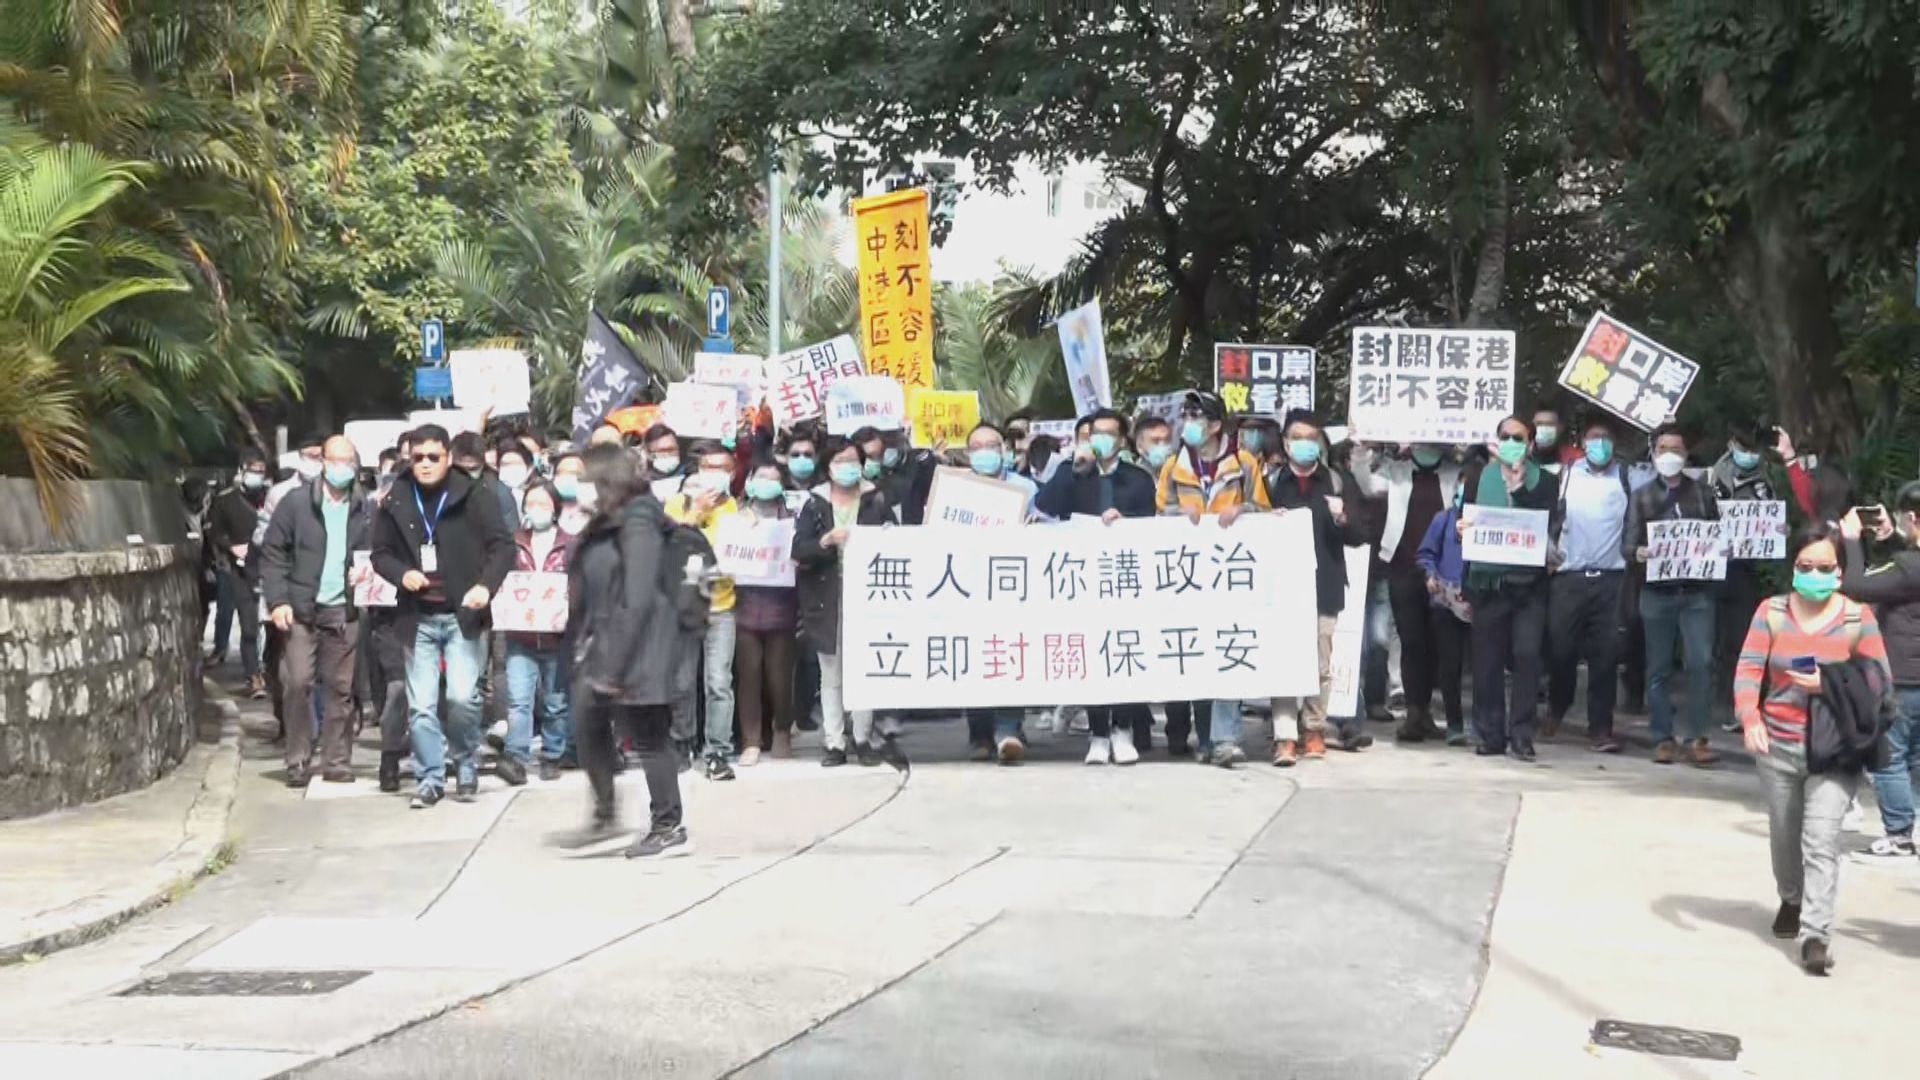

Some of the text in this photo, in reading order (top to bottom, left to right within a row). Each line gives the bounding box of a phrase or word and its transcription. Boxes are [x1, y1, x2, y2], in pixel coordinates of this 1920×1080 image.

[711, 292, 725, 330] P
[895, 217, 926, 388] 刻不容緩
[424, 324, 440, 357] P
[1357, 332, 1510, 371] 封關保港
[780, 342, 838, 378] 立即
[1220, 350, 1310, 380] 封口岸
[1357, 373, 1509, 411] 刻不容緩
[865, 541, 1257, 601] 無人同你講政治
[865, 622, 1260, 682] 立即封關保平安
